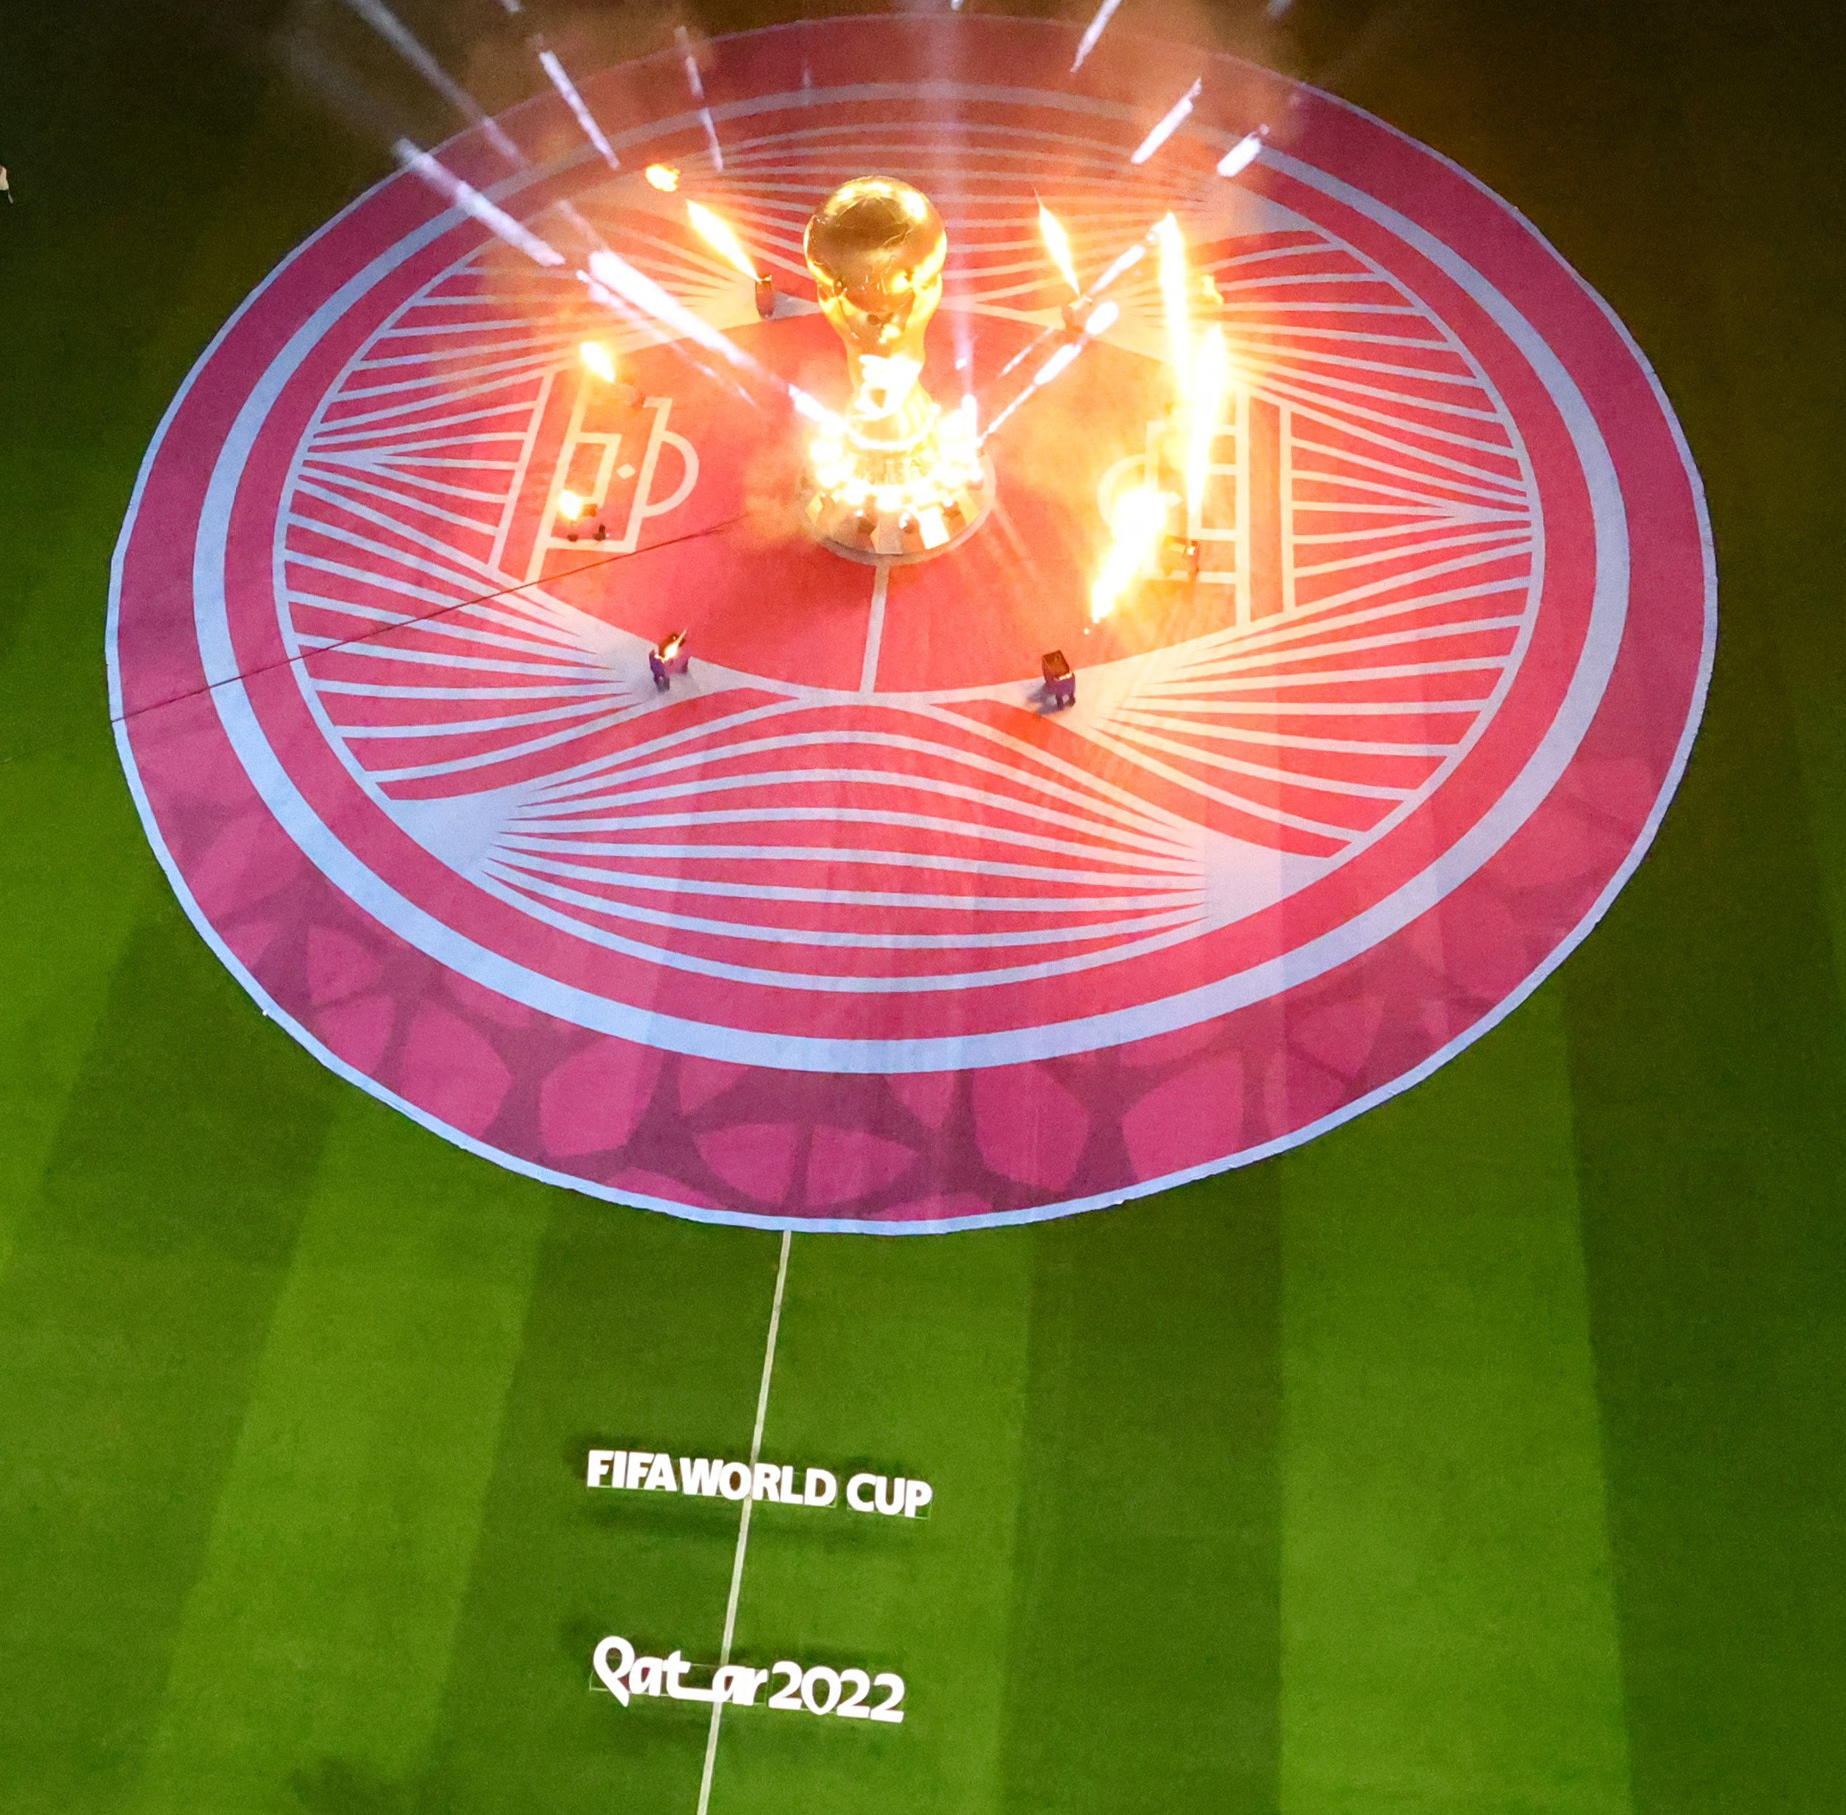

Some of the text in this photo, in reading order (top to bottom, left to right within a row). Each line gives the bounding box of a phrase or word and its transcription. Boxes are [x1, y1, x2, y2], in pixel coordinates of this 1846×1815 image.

[587, 1450, 933, 1518] FIFA WORLD CUP
[593, 1636, 905, 1723] Qatar 2022
